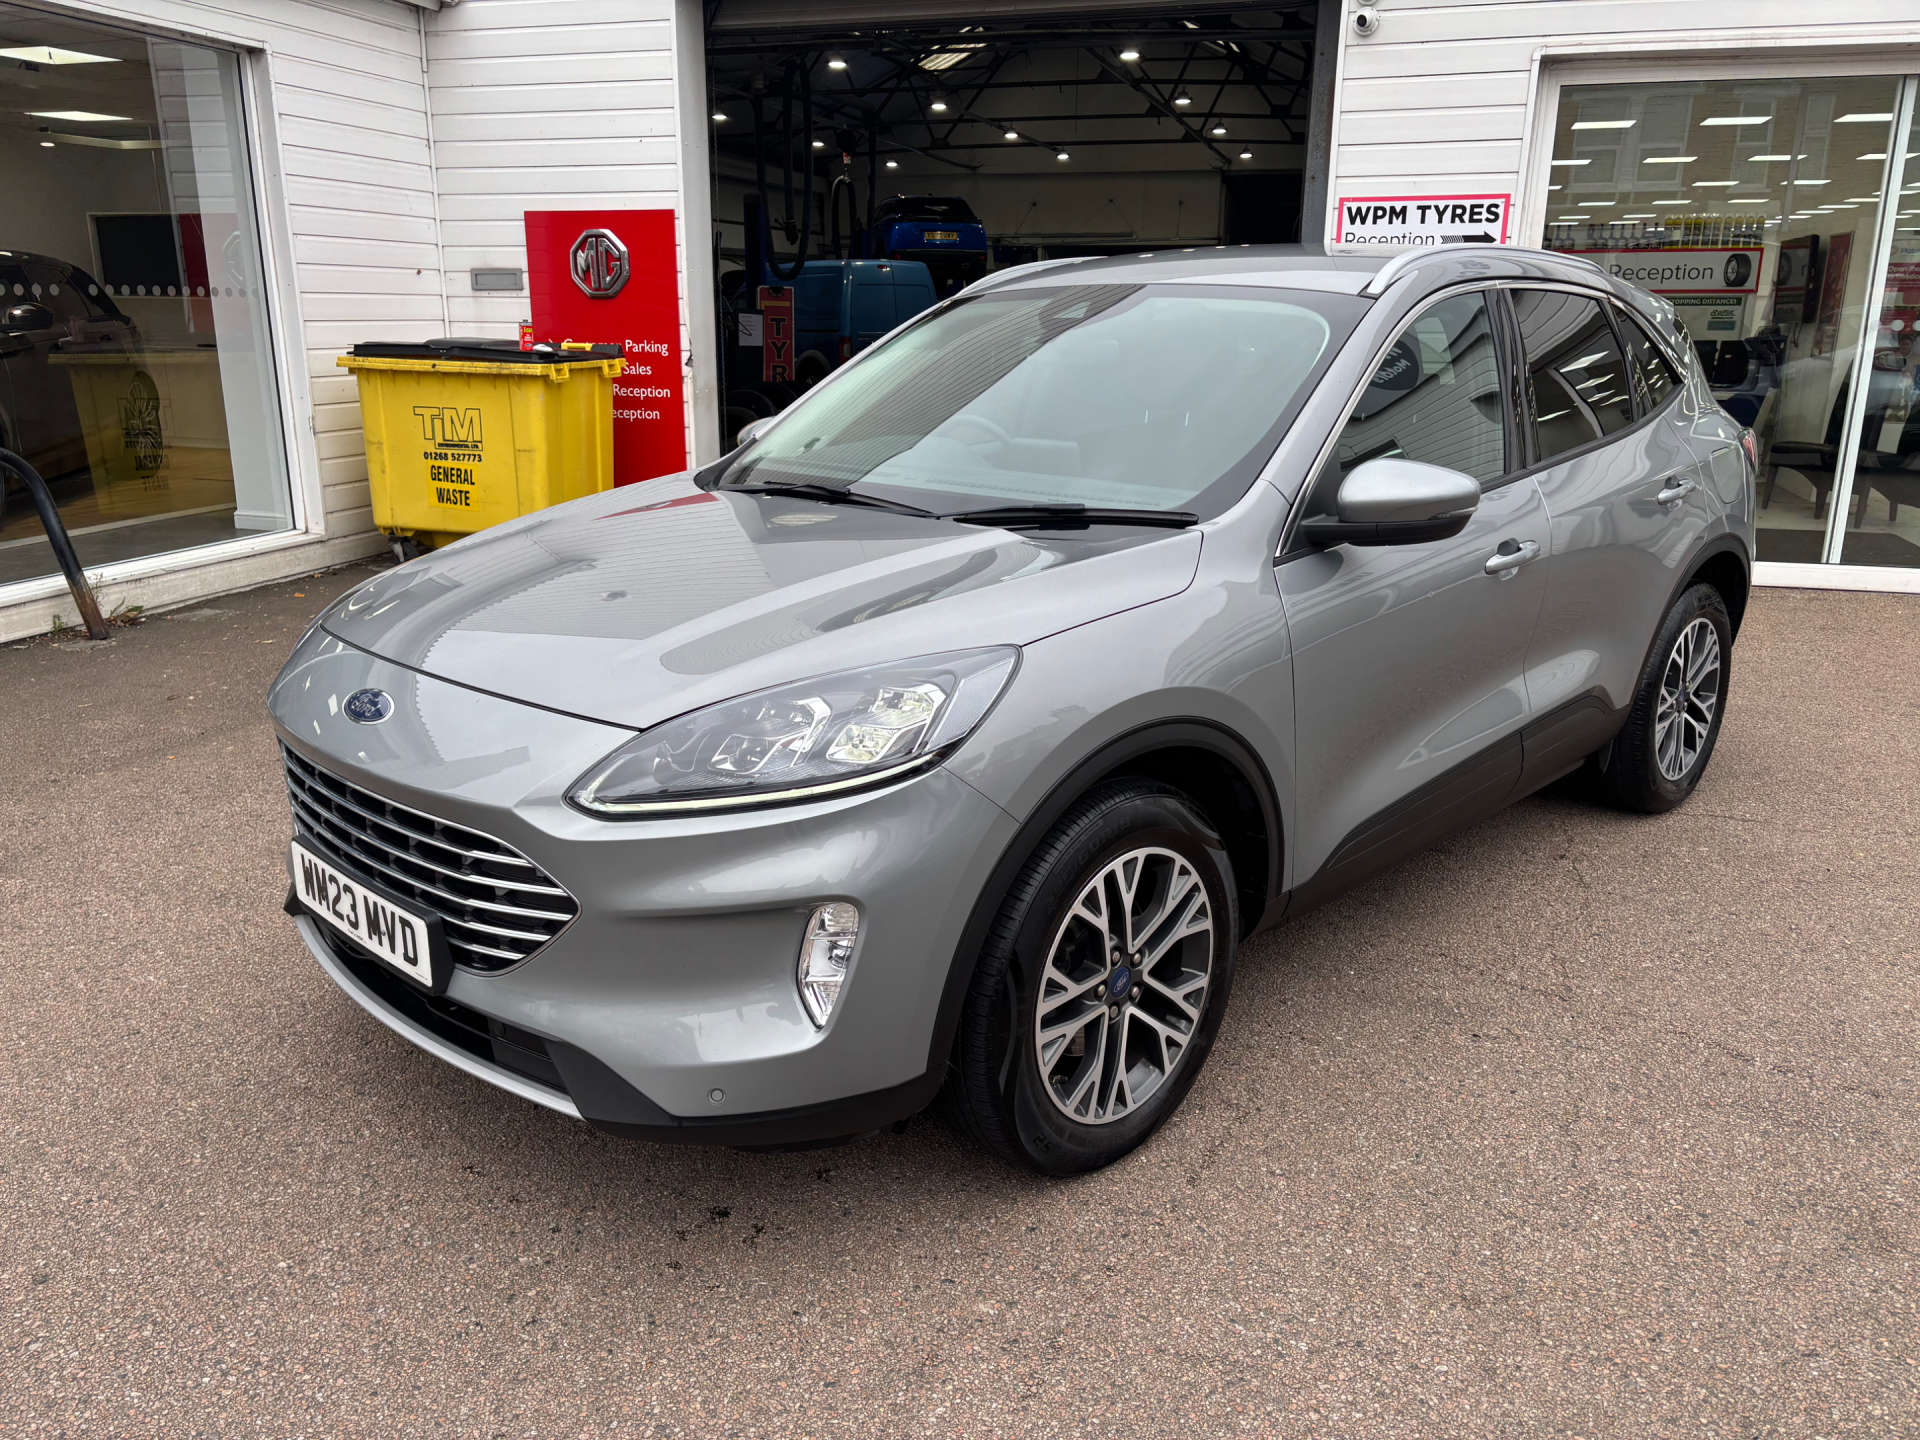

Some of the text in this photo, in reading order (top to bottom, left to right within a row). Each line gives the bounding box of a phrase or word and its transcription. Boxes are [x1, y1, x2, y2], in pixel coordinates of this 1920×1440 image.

[1346, 203, 1501, 226] WPM TYRES
[575, 236, 624, 292] MG
[1609, 264, 1714, 284] Reception
[625, 339, 669, 357] Parking
[623, 362, 652, 375] Sales
[612, 384, 671, 400] Reception
[611, 408, 660, 422] eception
[424, 451, 482, 463] 01268 527773
[430, 464, 476, 486] GENERAL
[436, 487, 471, 507] WASTE
[301, 853, 419, 968] WM23 MVD
